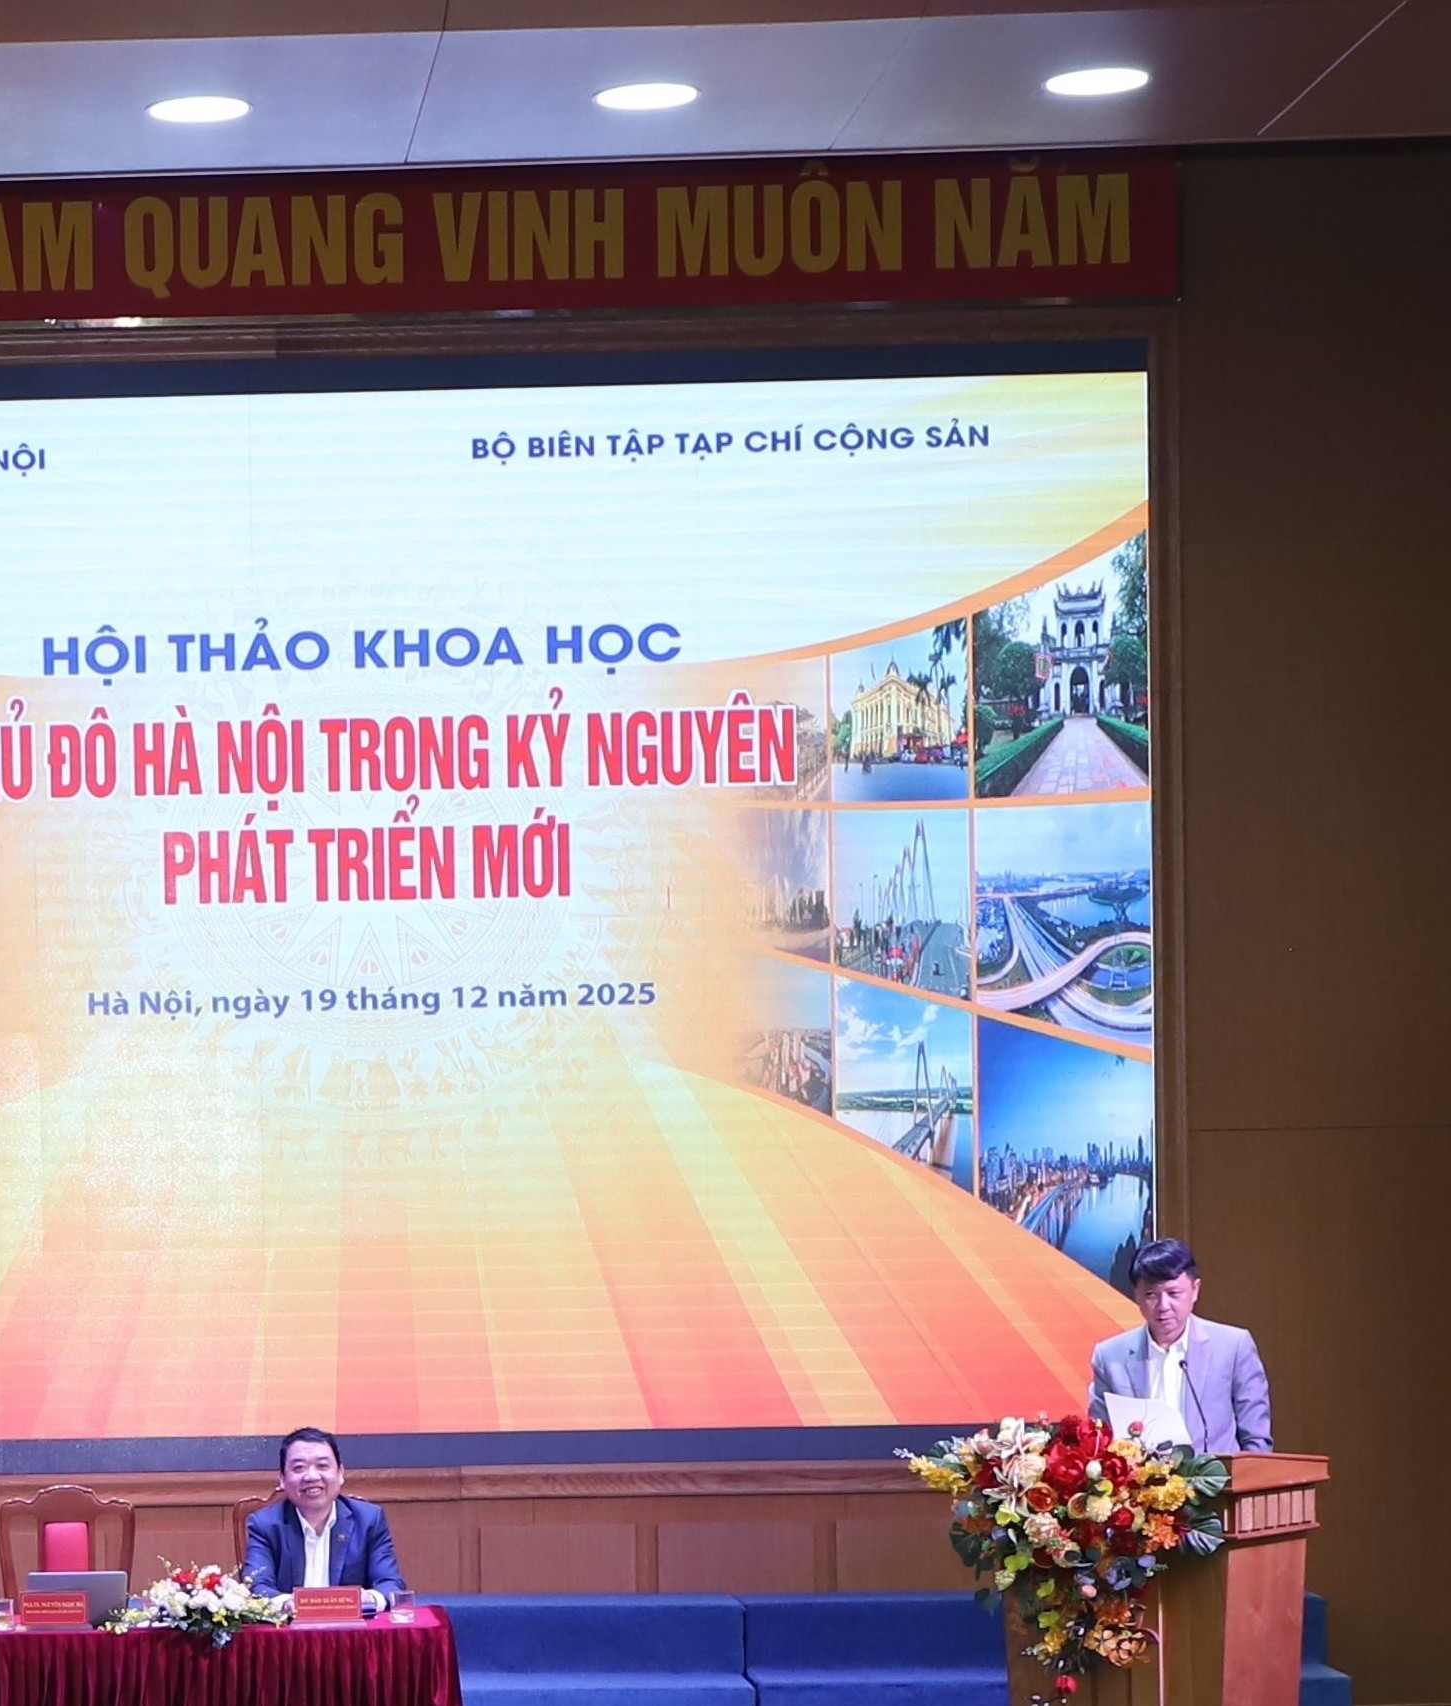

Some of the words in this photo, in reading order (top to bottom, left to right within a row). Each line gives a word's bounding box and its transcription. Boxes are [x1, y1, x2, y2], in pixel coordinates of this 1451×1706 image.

[124, 192, 404, 298] QUANG
[433, 189, 624, 282] VINH
[657, 161, 902, 279] MUÔN
[934, 155, 1130, 269] NĂM
[472, 431, 516, 465] BỘ
[528, 430, 595, 459] BIÊN
[606, 427, 664, 461] TẬP
[675, 431, 733, 461] TẠP
[745, 424, 802, 454] CHÍ
[813, 423, 914, 457] CỘNG
[926, 418, 989, 450] SẢN
[43, 624, 146, 687] HỘI
[169, 618, 329, 674] THẢO
[354, 626, 523, 669] KHOA
[546, 622, 682, 675] HỌC
[47, 706, 117, 798] ĐÔ
[133, 705, 202, 796] HÀ
[217, 703, 304, 811] NỘI
[320, 715, 489, 791] TRONG
[507, 687, 570, 788] KỶ
[587, 692, 795, 785] NGUYÊN
[163, 813, 294, 905] PHÁT
[308, 794, 454, 901] TRIỂN
[473, 807, 570, 898] MỚI
[87, 992, 129, 1015] Hà
[139, 990, 202, 1020] Nội,
[212, 989, 290, 1018] ngày
[301, 989, 337, 1012] 19
[346, 985, 440, 1015] tháng
[453, 985, 488, 1008] 12
[499, 983, 568, 1007] năm
[577, 982, 657, 1006] 2025
